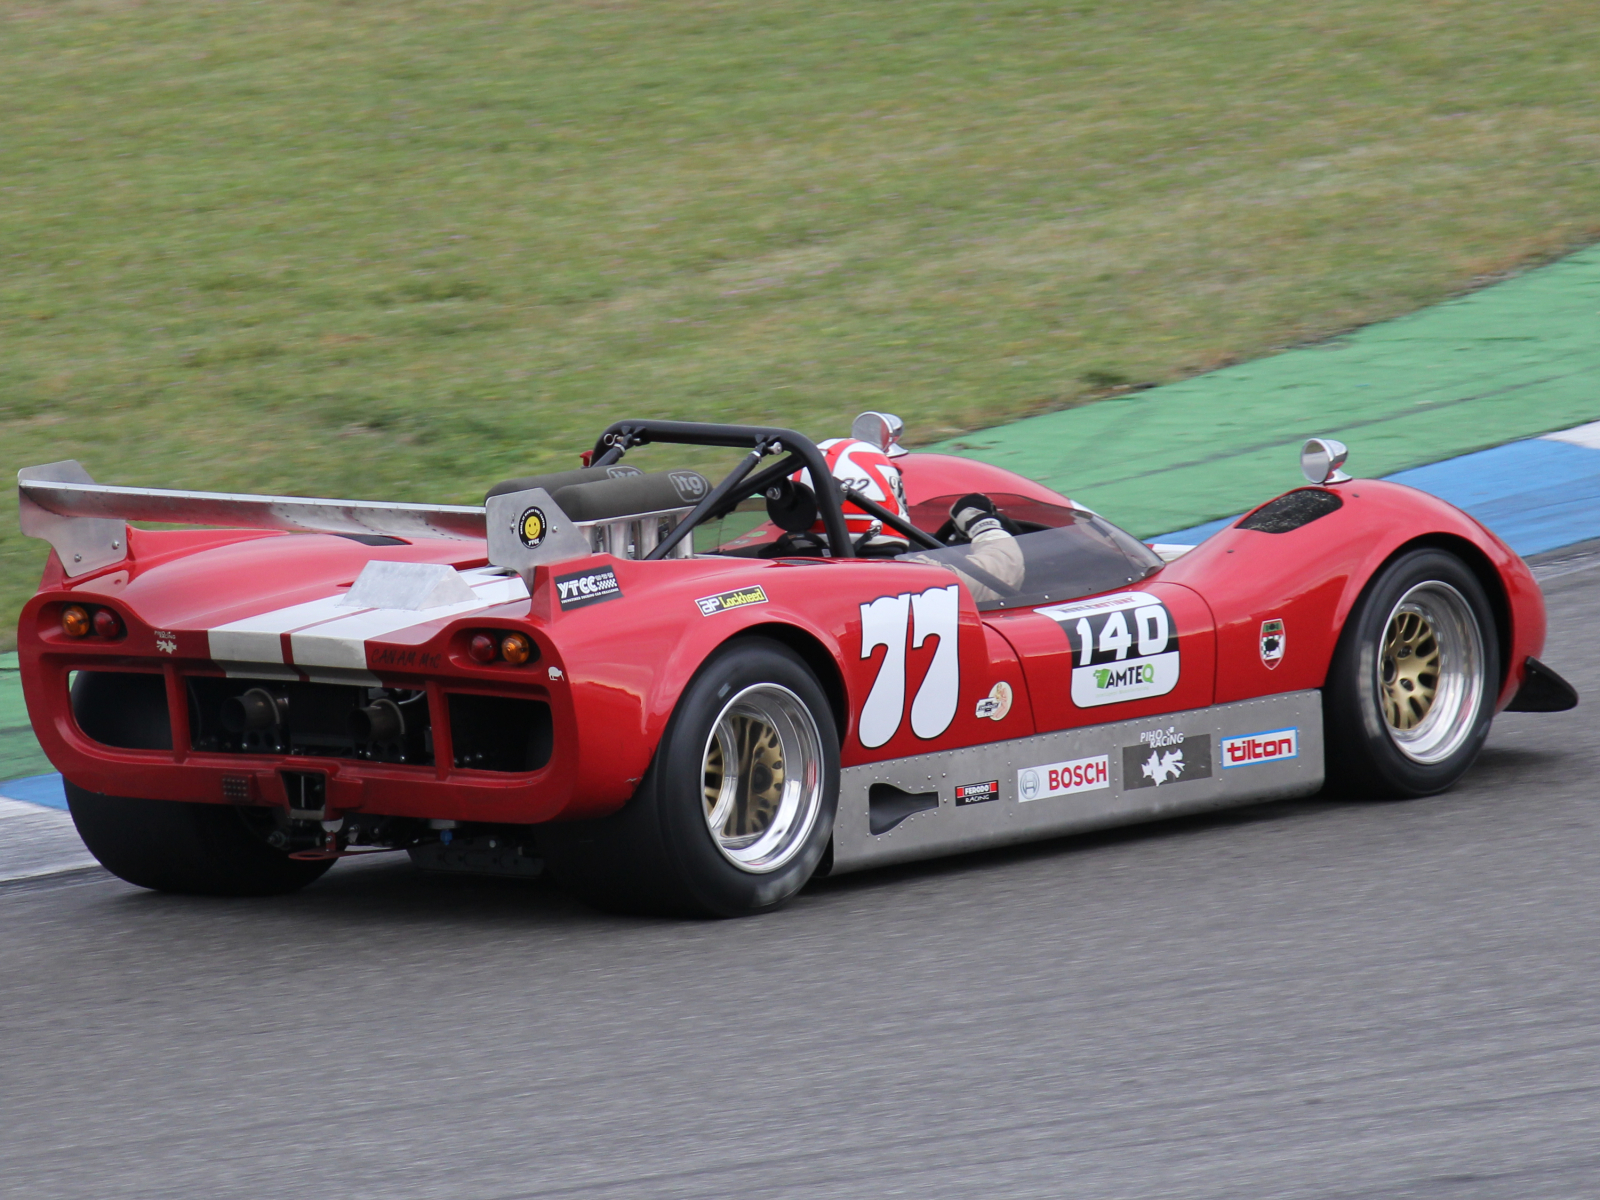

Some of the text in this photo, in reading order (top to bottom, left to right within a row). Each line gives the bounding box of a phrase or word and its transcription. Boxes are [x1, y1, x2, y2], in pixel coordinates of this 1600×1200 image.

[556, 575, 598, 599] YTCC
[718, 588, 765, 608] Lockheed
[1075, 604, 1169, 666] 140
[859, 584, 960, 749] 77
[1140, 729, 1163, 743] PIHO
[1227, 738, 1293, 763] tilton
[1048, 761, 1107, 791] BOSCH
[964, 784, 989, 795] FERODO
